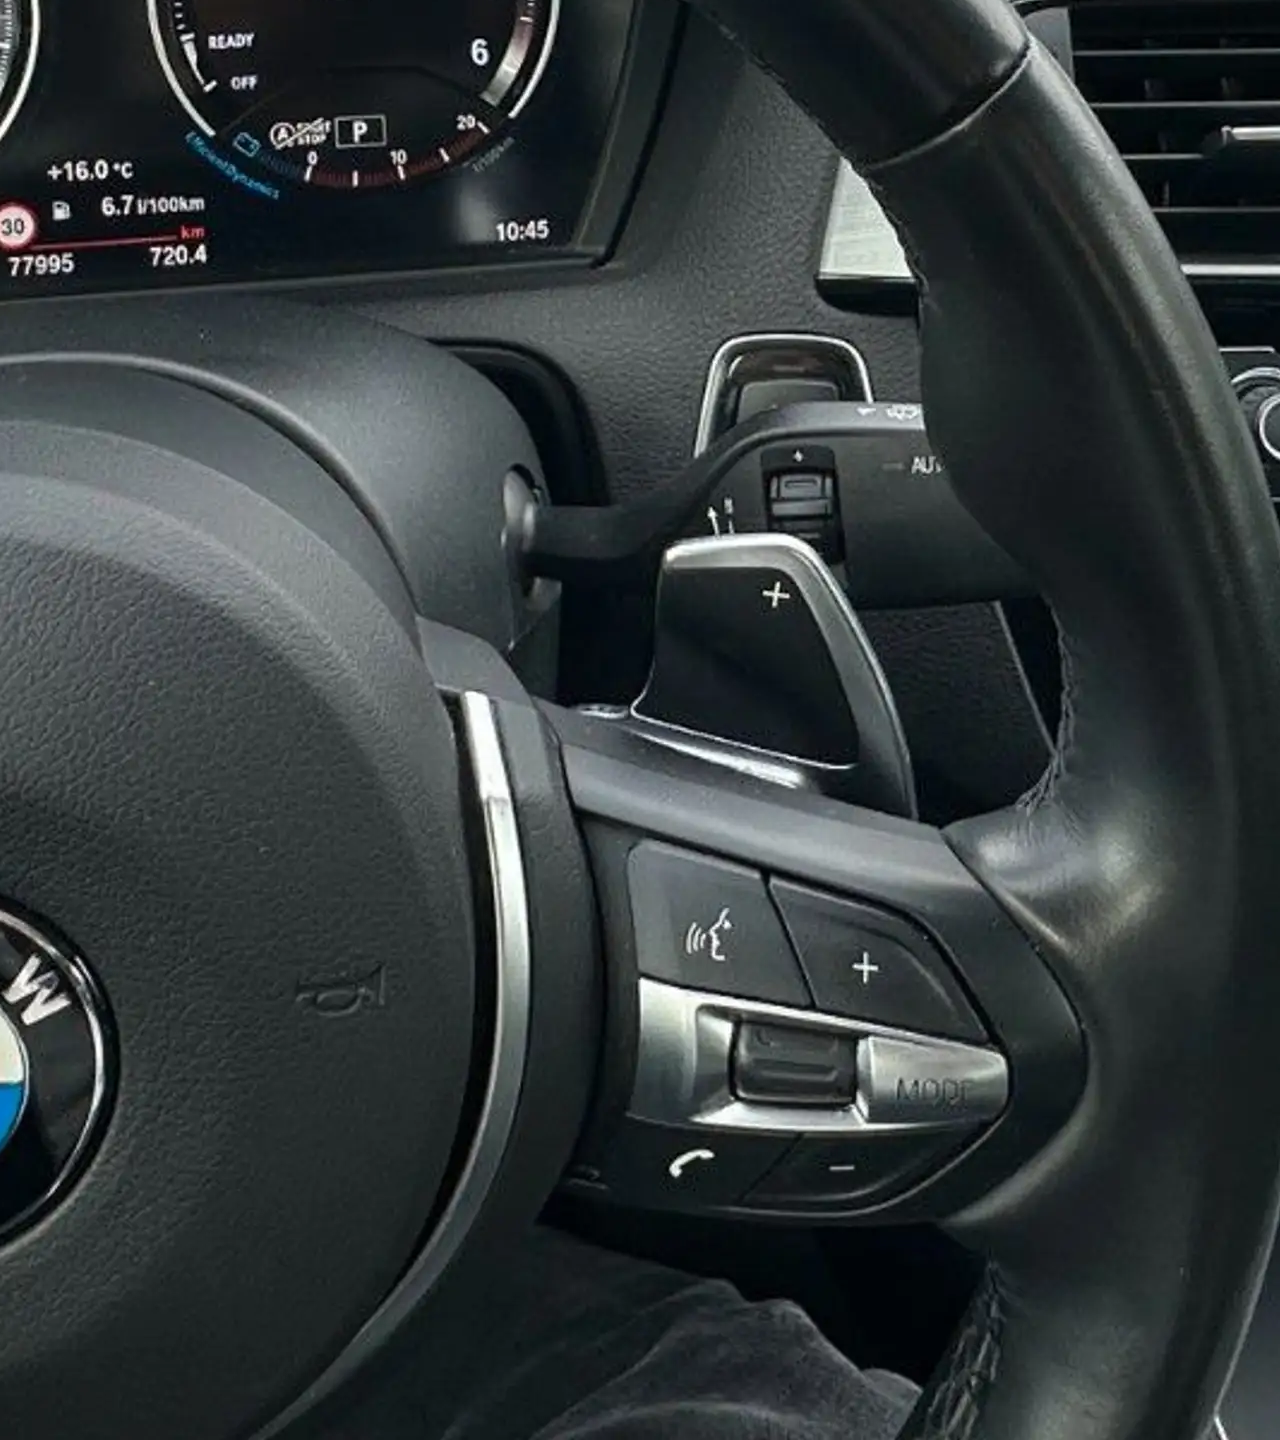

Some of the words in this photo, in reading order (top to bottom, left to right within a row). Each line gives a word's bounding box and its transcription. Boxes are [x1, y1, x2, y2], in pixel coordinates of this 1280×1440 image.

[208, 33, 255, 50] READY
[471, 38, 490, 66] 6
[230, 74, 259, 90] OFF
[353, 121, 368, 143] P
[455, 114, 476, 130] 20
[307, 151, 319, 165] 0
[389, 148, 408, 165] 10
[47, 160, 109, 181] +16.0
[101, 195, 134, 216] 6.7
[0, 218, 26, 237] 30
[180, 225, 206, 238] km
[496, 218, 550, 241] 10:45
[7, 252, 76, 277] 77995
[149, 244, 208, 267] 720.4
